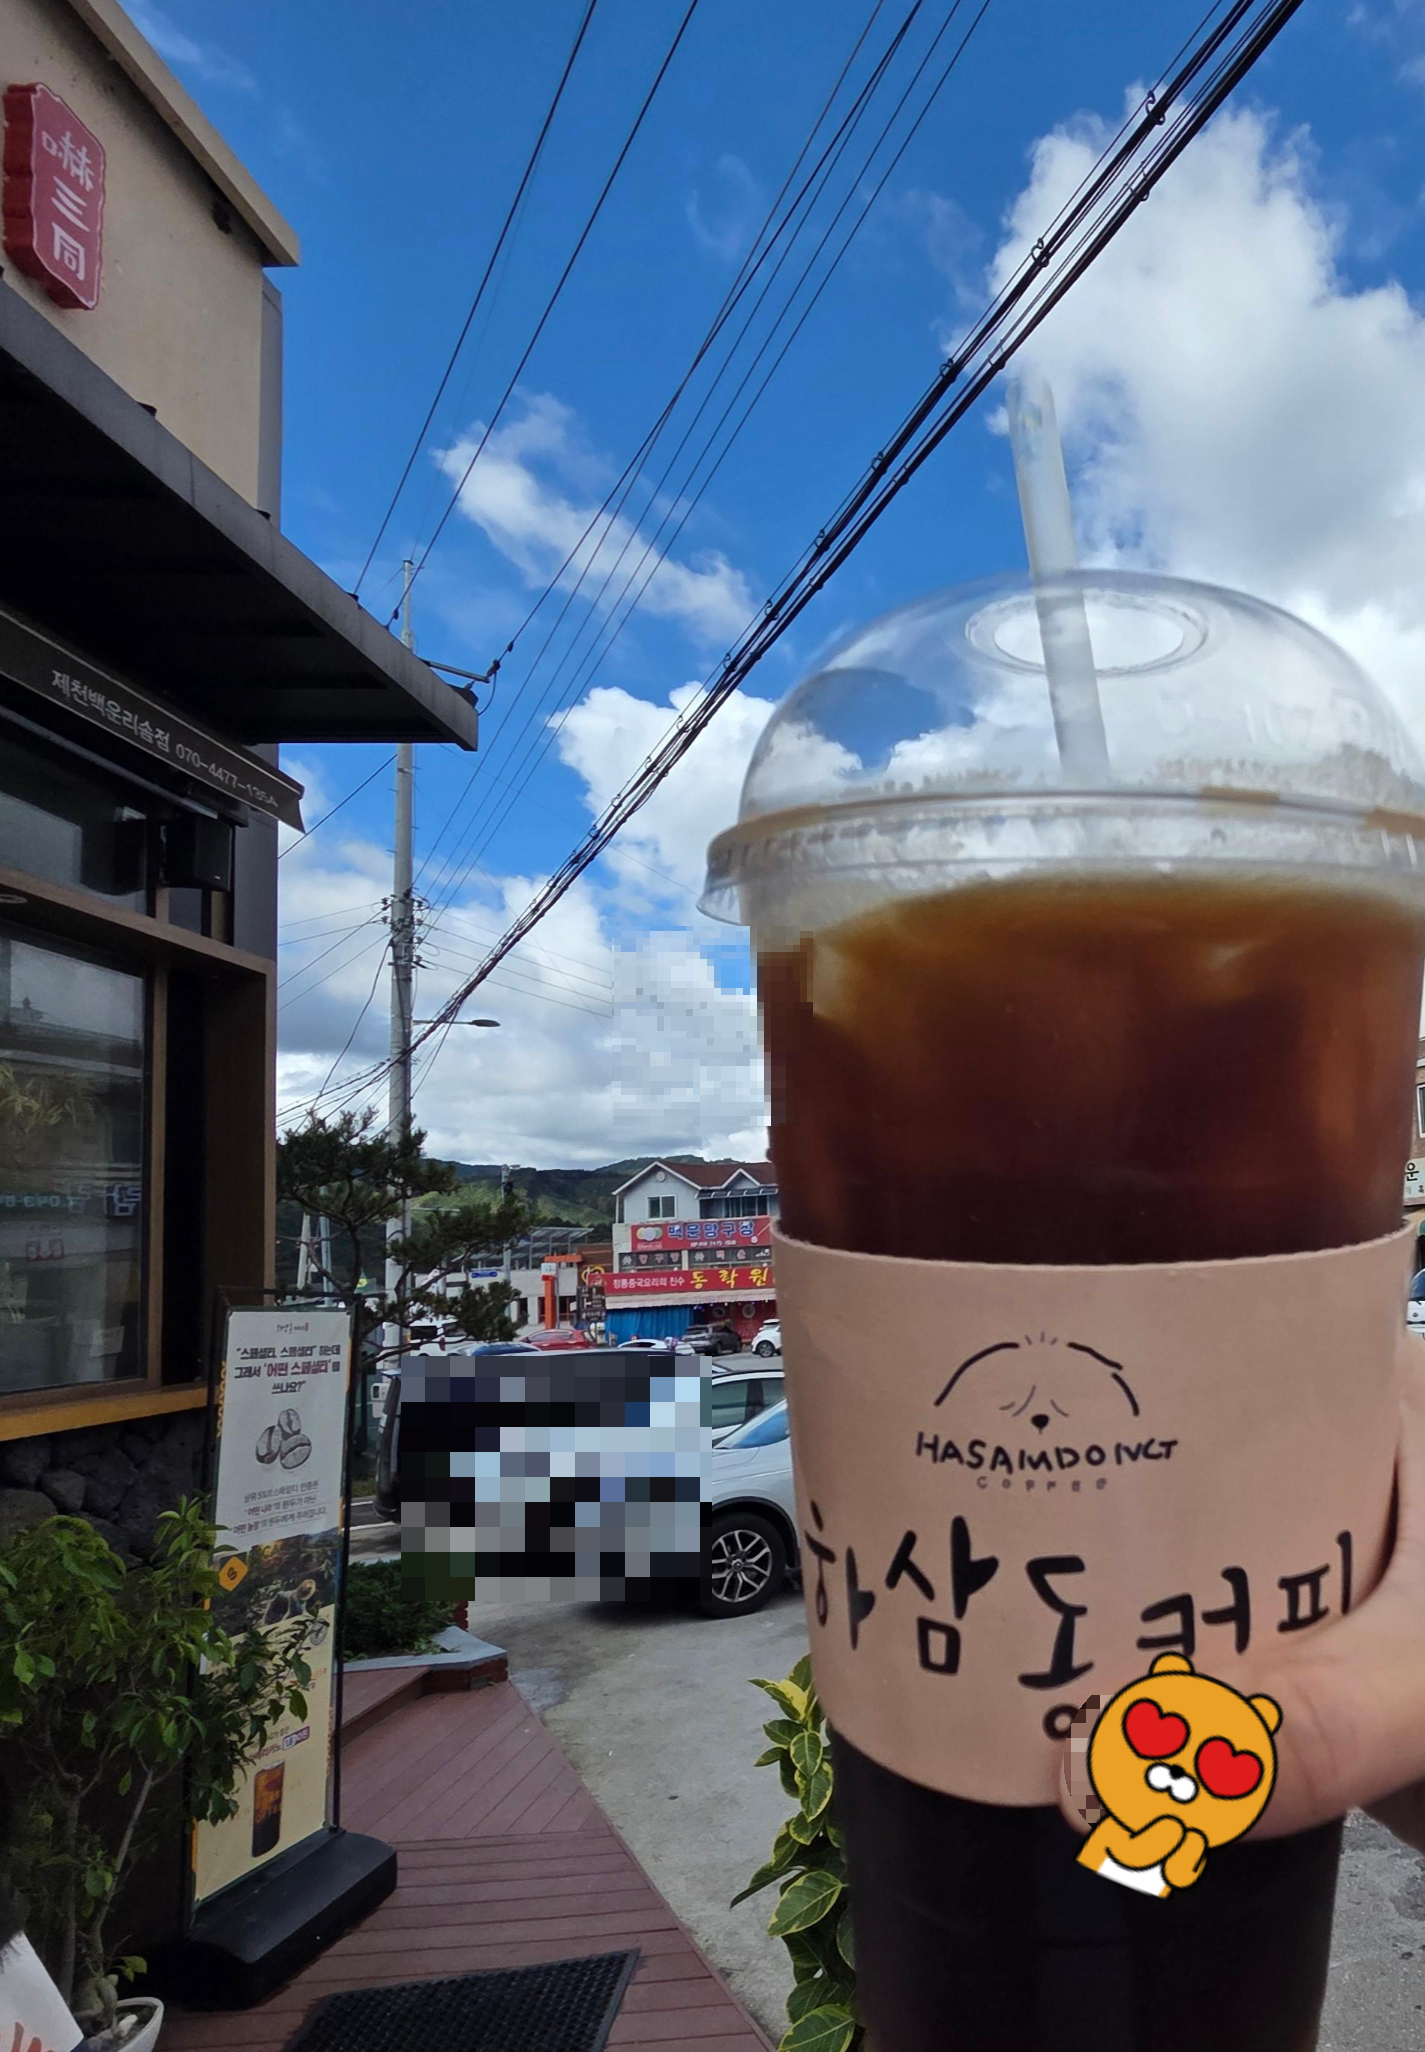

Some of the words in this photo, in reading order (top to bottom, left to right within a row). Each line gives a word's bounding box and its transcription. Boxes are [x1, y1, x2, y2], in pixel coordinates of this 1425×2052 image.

[667, 1220, 755, 1240] 백운당구장
[976, 1476, 1108, 1492] COFFEE
[1137, 1530, 1354, 1656] 커피
